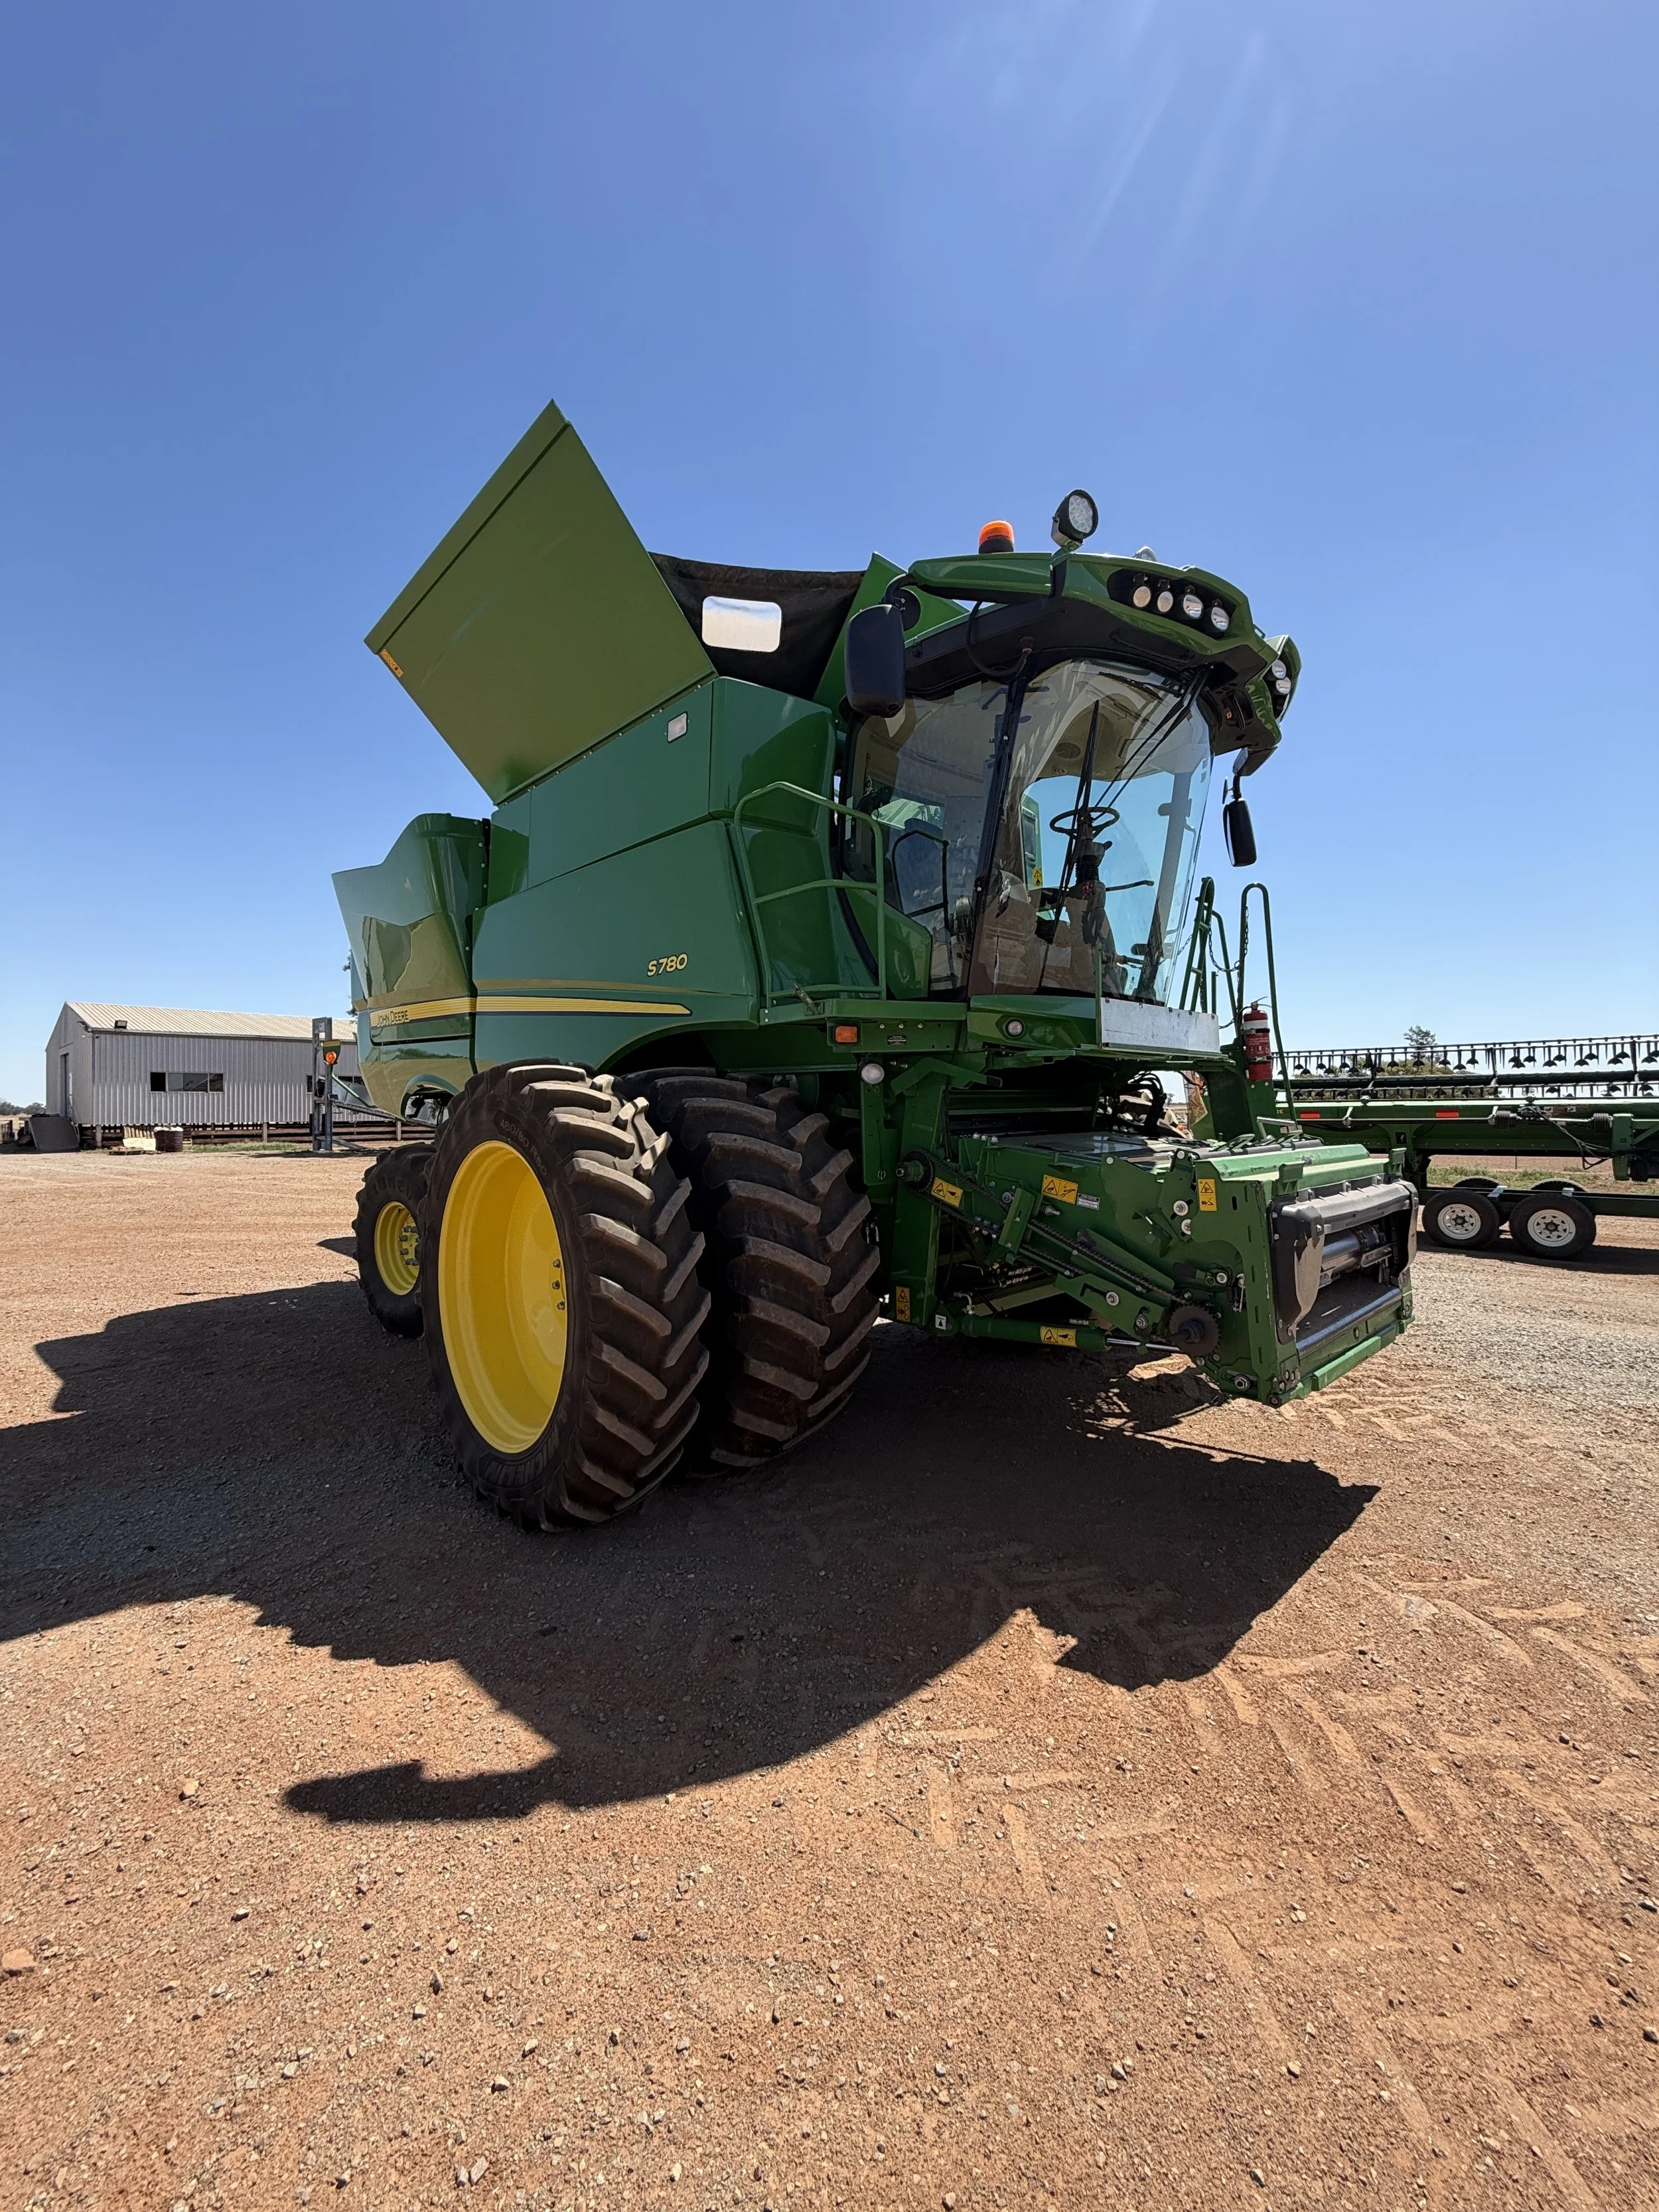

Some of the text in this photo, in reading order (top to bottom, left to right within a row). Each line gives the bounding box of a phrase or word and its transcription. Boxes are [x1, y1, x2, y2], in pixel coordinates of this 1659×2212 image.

[647, 952, 688, 977] S780
[377, 1010, 409, 1025] JOHN DEERE
[483, 1422, 559, 1485] MICHELIN
